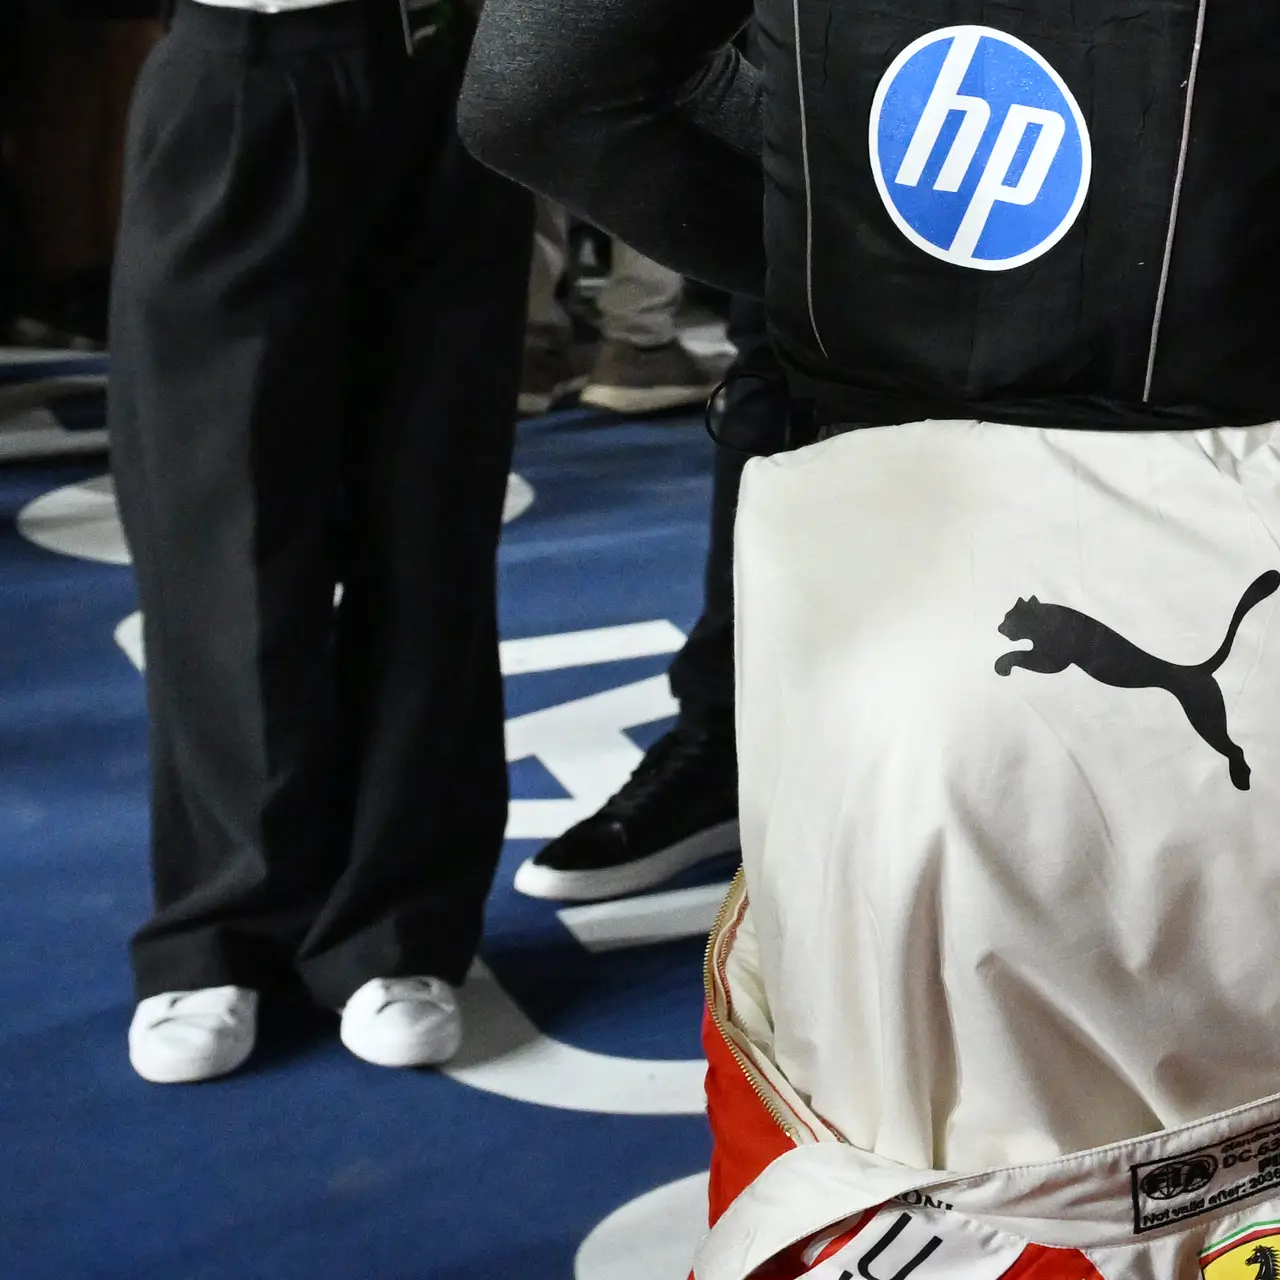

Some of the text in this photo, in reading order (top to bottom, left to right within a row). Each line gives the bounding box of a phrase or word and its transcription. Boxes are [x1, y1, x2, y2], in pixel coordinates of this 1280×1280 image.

[890, 28, 1070, 267] hp
[1142, 1209, 1170, 1227] Not
[1172, 1195, 1205, 1218] valid
